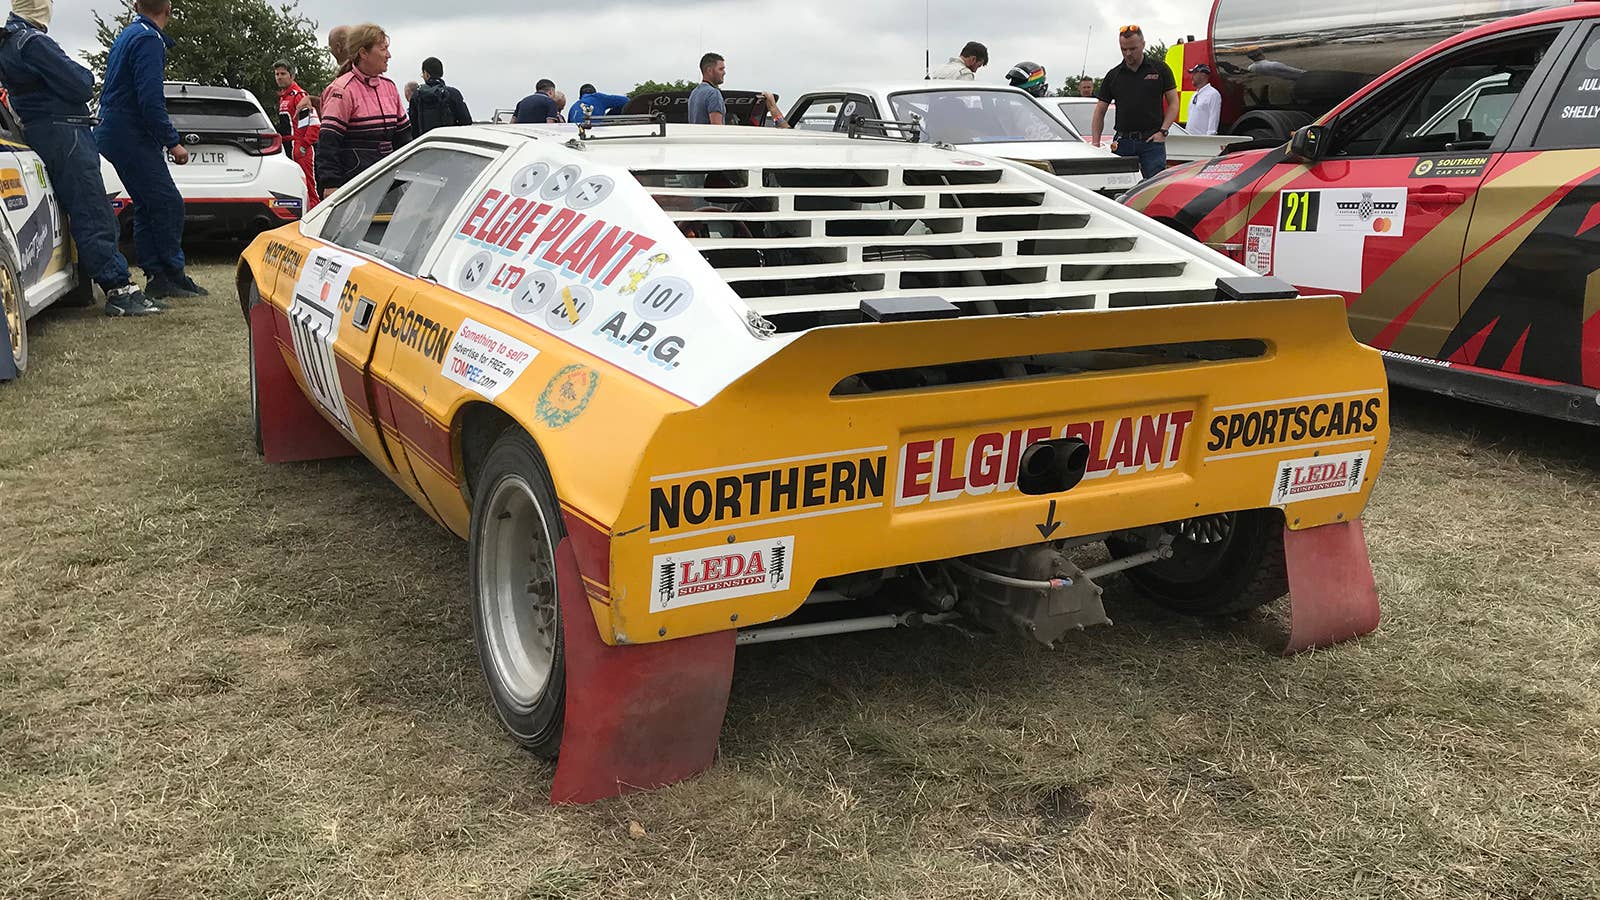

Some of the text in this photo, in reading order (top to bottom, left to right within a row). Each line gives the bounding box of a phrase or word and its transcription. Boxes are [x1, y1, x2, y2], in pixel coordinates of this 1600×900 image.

[1578, 78, 1600, 91] JUL
[1562, 105, 1600, 119] SHELLY
[202, 152, 225, 163] LTR
[1437, 157, 1488, 167] SOUTHERN
[1284, 191, 1309, 231] 21
[458, 189, 658, 287] ELGIE PLANT
[491, 263, 527, 291] LTD
[641, 284, 683, 312] 101
[382, 301, 454, 364] SCORTON
[460, 325, 529, 364] Something to sell?
[450, 356, 498, 390] TOMPEE.com
[453, 341, 515, 378] Advertise for FREE on
[649, 456, 887, 532] NORTHERN
[898, 427, 1051, 505] ELGI
[1207, 397, 1381, 452] SPORTSCARS
[1291, 461, 1348, 486] LEDA
[1290, 480, 1346, 494] SUSPENSION
[678, 550, 767, 587] LEDA
[678, 575, 765, 597] SUSPENSION
